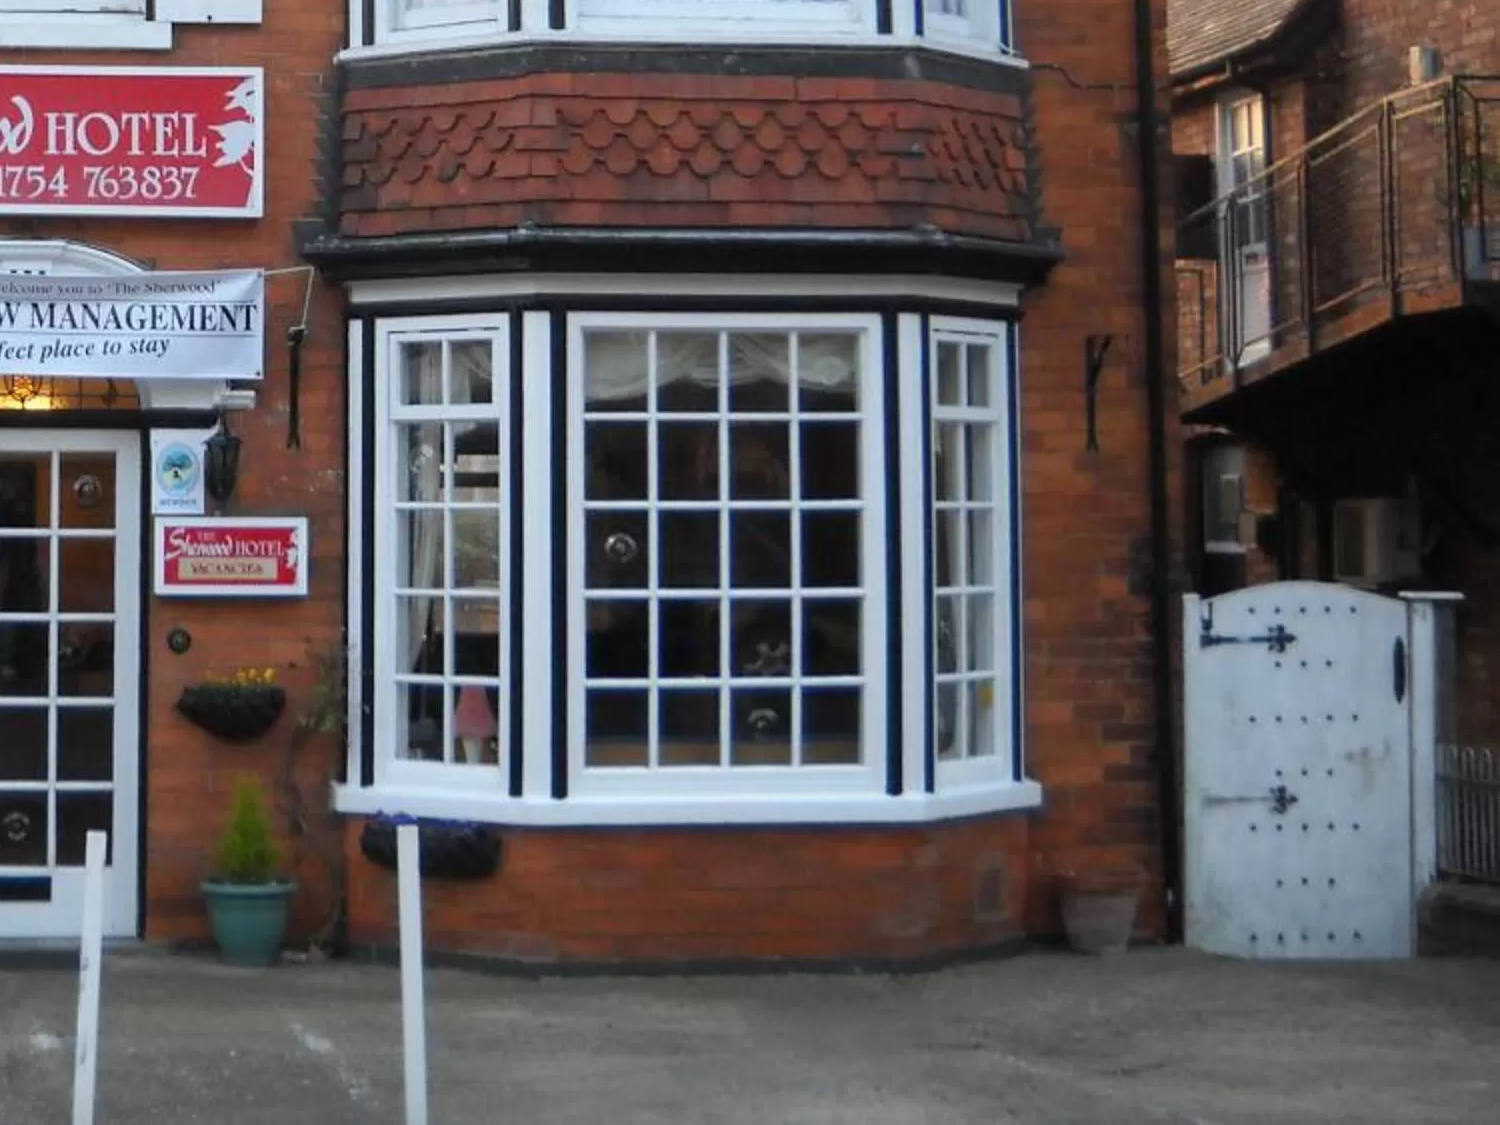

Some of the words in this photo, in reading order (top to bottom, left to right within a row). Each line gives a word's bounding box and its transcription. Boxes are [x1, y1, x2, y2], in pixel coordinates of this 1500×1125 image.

[44, 111, 207, 158] HOTEL
[84, 165, 199, 199] 763837
[30, 302, 258, 333] MANAGEMENT
[40, 338, 98, 363] place
[102, 338, 122, 356] to
[128, 336, 171, 358] stay
[235, 539, 284, 556] HOTEL
